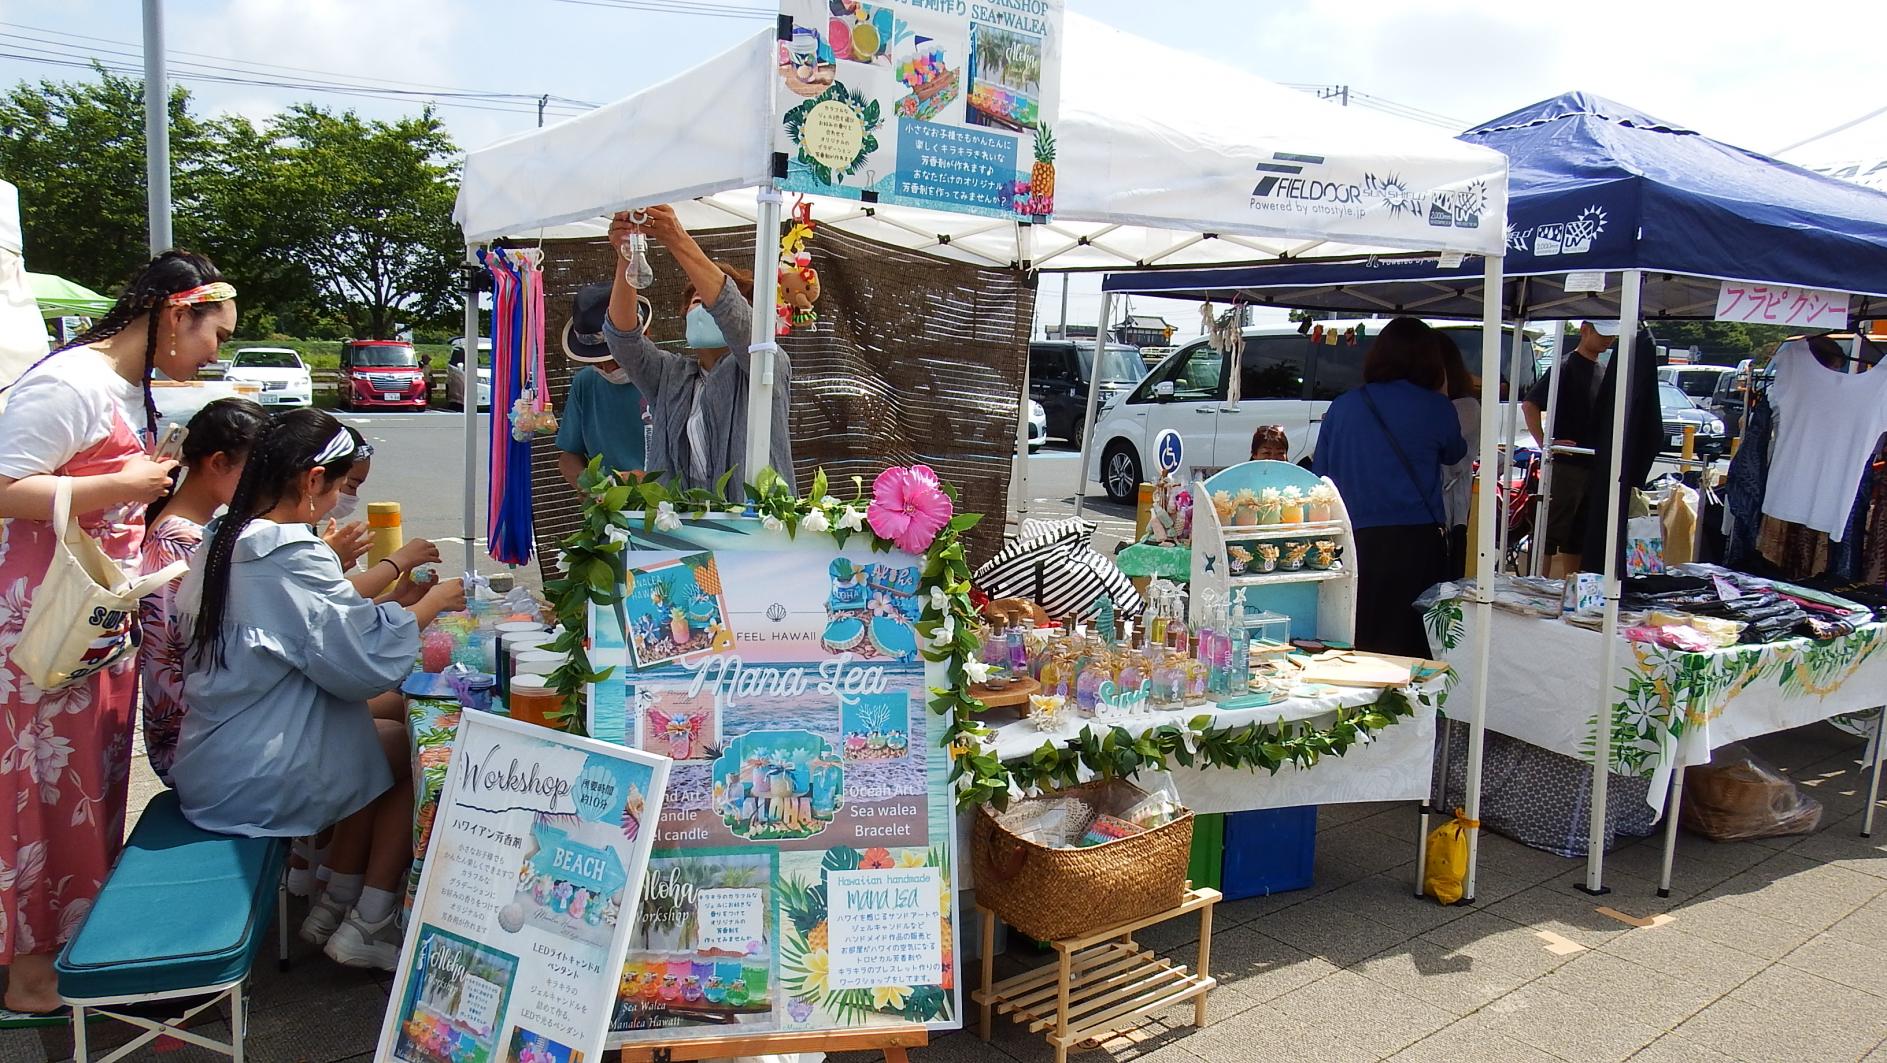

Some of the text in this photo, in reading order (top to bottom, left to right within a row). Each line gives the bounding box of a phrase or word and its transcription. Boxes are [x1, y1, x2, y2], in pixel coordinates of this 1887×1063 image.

[971, 4, 1048, 36] SEA WALEA
[1276, 177, 1362, 204] FIELDOOR
[1249, 197, 1292, 212] Powered
[1296, 201, 1308, 215] by
[1719, 287, 1847, 323] フラピクシー
[736, 631, 817, 642] FEEL HAWAII
[680, 655, 888, 708] Mana Lea
[462, 743, 572, 809] Workshop
[581, 778, 615, 796] 所要時間
[895, 784, 915, 797] Art
[681, 790, 702, 802] Art
[660, 809, 697, 822] andle
[850, 803, 917, 817] Sea walea
[664, 827, 709, 841] candle
[855, 823, 911, 837] Bracelet
[553, 847, 607, 881] BEACH
[838, 873, 931, 887] Hawaiian handmade
[622, 999, 666, 1014] Sea Walea
